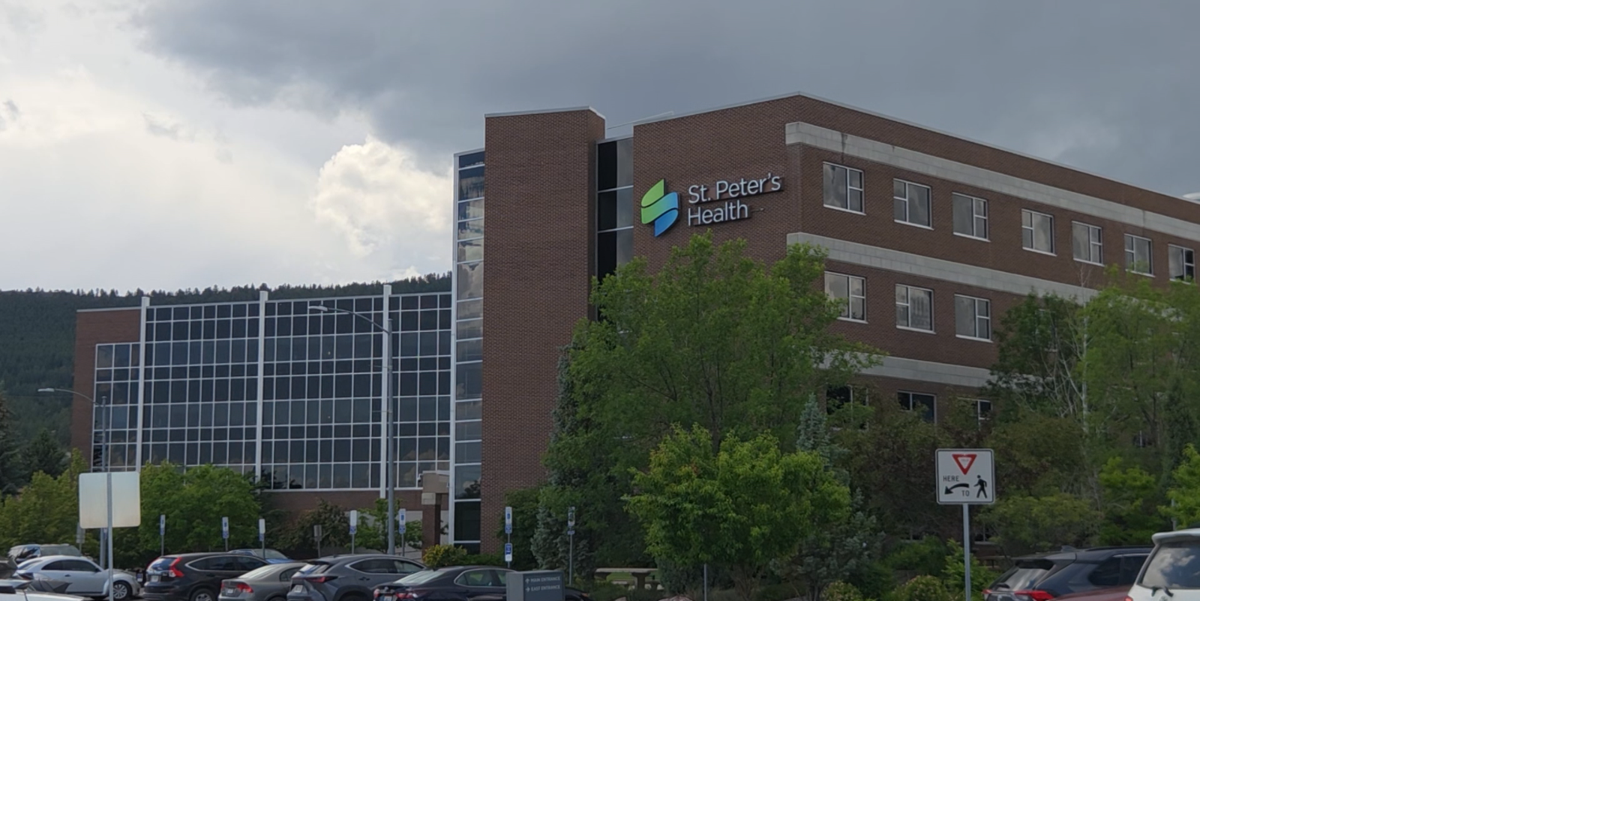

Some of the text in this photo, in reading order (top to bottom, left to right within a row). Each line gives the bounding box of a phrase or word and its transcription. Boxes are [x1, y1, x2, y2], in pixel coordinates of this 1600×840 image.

[688, 172, 781, 204] St. Peter's
[688, 200, 748, 226] Health
